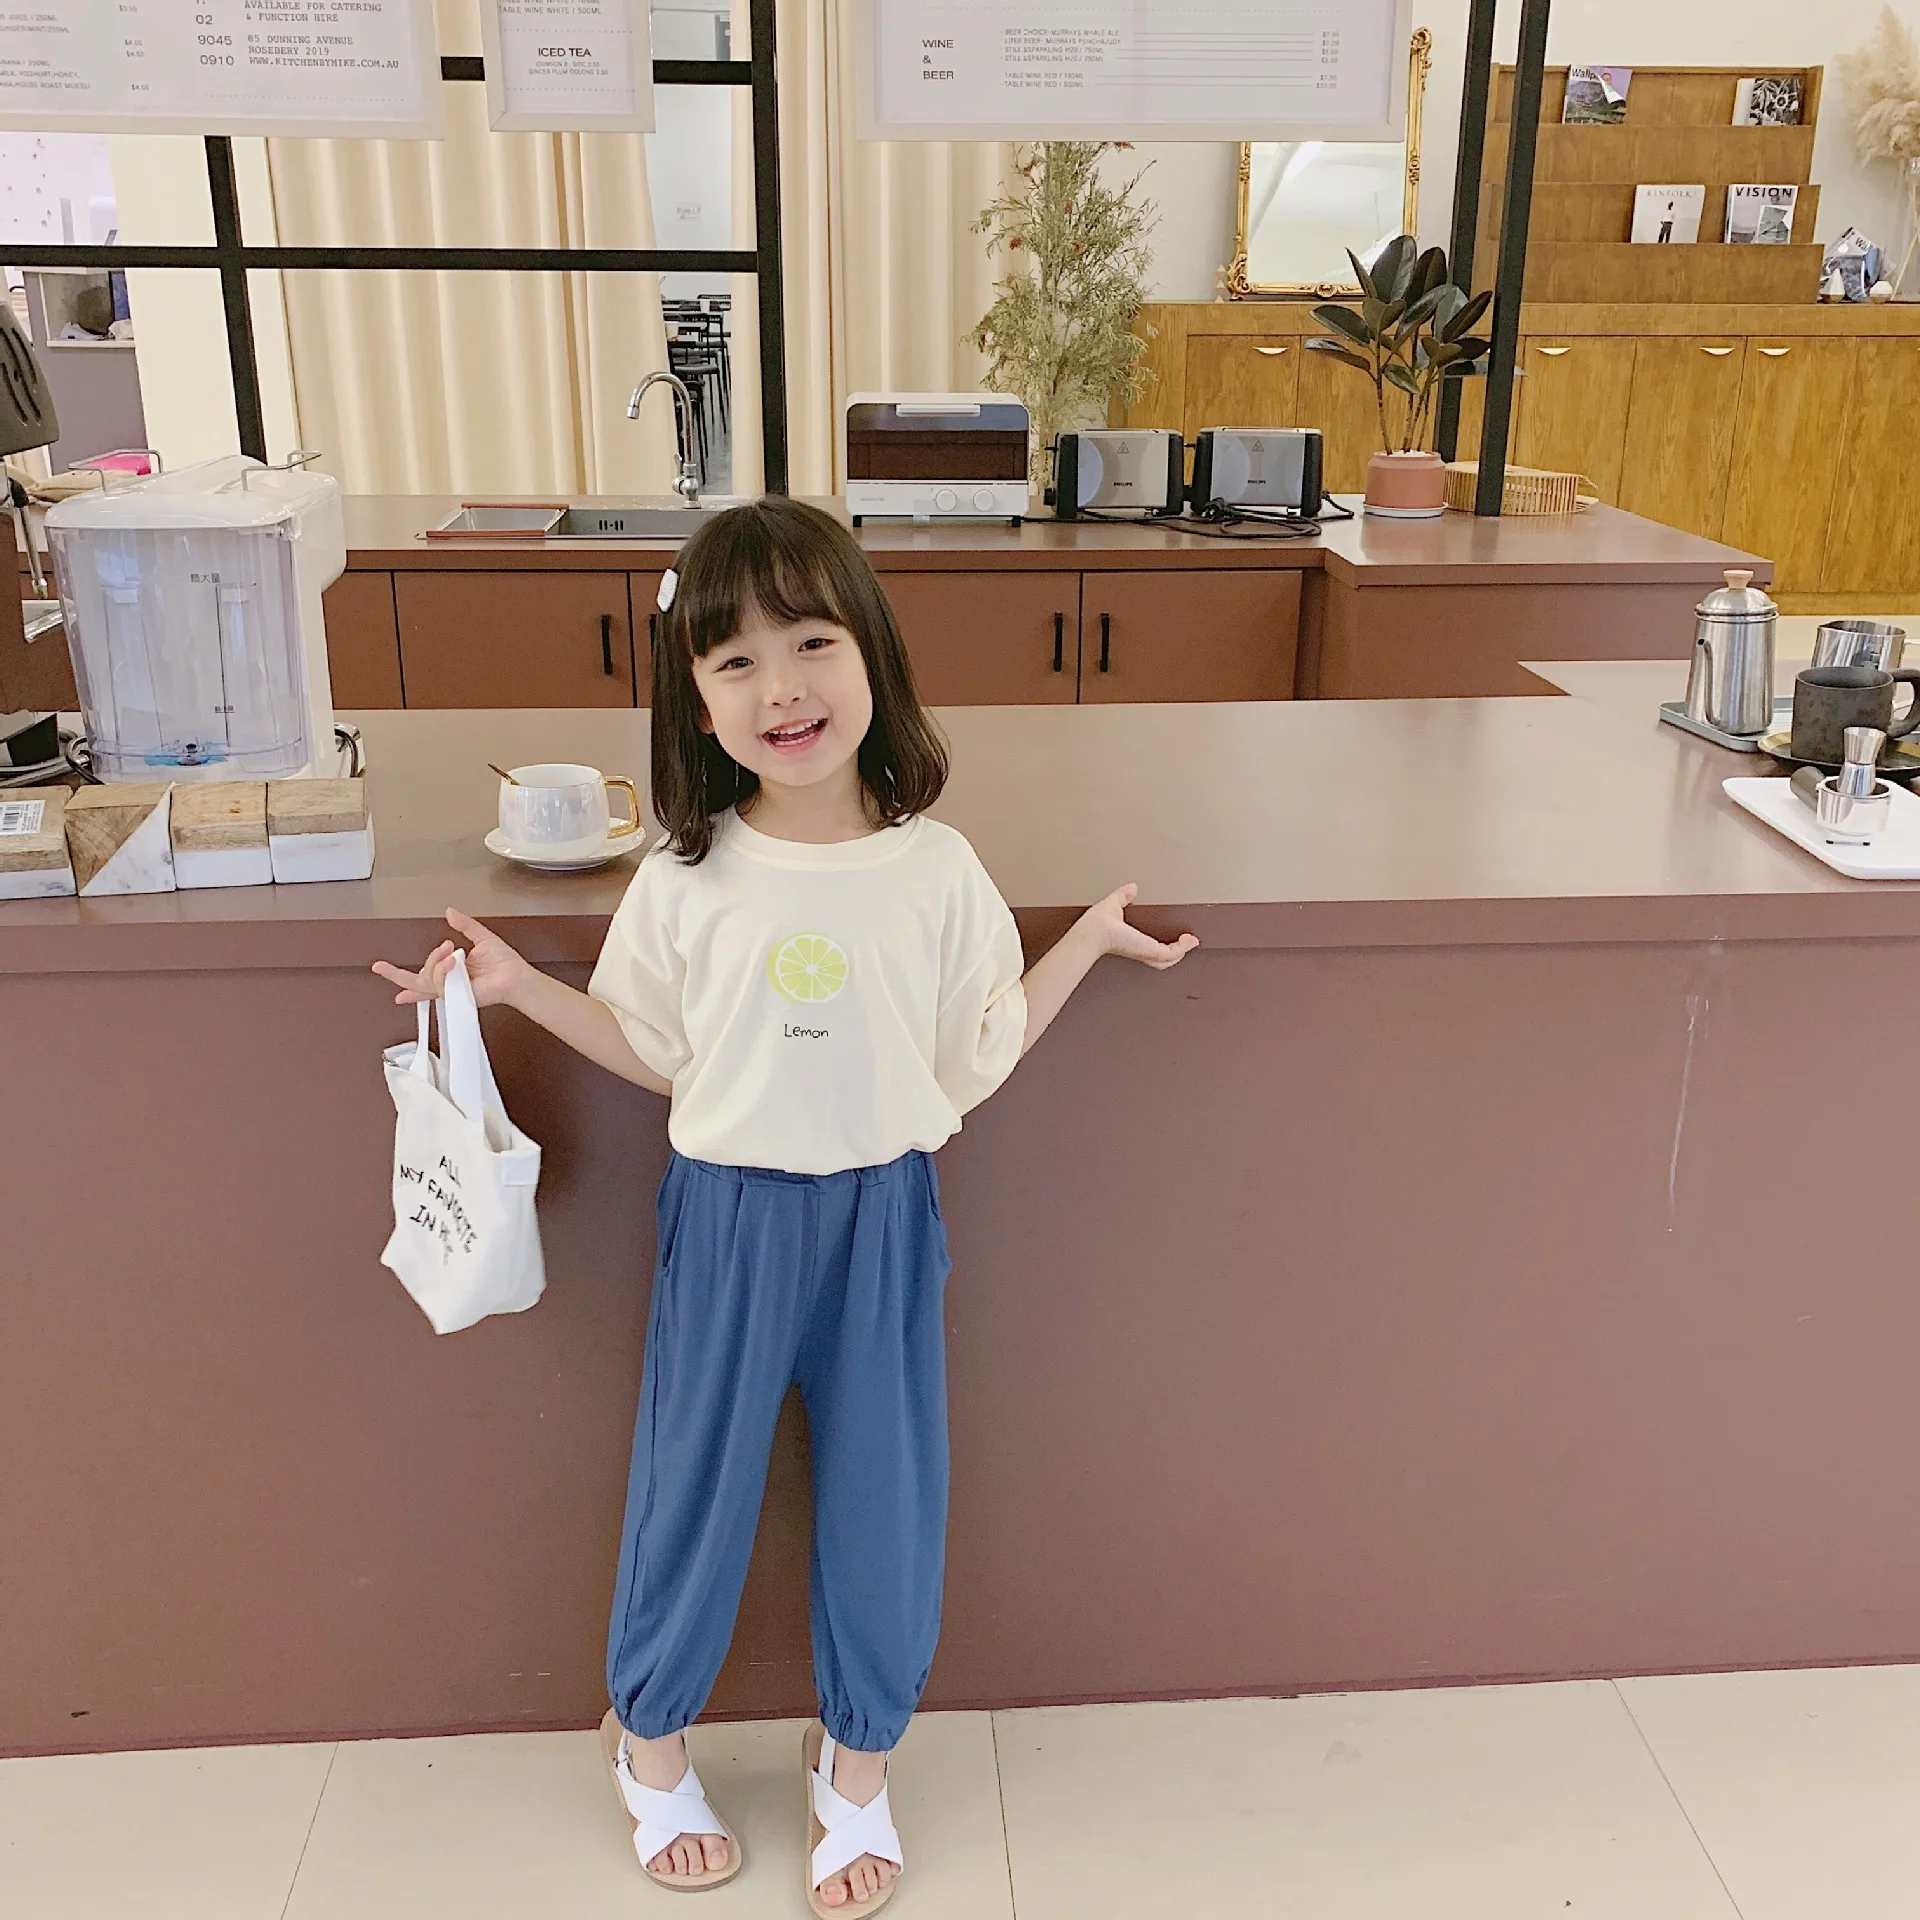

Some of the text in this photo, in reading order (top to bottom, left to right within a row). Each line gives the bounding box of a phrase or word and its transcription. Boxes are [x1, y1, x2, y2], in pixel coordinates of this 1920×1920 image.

[244, 1, 382, 12] AVAILABLE FOR CATERING
[524, 6, 543, 14] WINE
[547, 6, 569, 14] WHITE
[195, 14, 213, 25] 02
[258, 12, 309, 21] FUNCTION
[314, 13, 339, 22] HIRE
[1005, 28, 1022, 36] BEER
[197, 34, 233, 45] 9045
[247, 34, 353, 45] 85 DUNNING AVENUE
[922, 39, 954, 48] WINE
[248, 46, 330, 56] ROSEBERY 2019
[538, 47, 592, 57] ICED TEA
[199, 54, 235, 66] 0910
[248, 57, 399, 69] WWW.KITCHENBYMIKE.COM.AU
[922, 54, 932, 64] &
[923, 70, 954, 80] BEER
[1735, 186, 1793, 198] VISION
[784, 1023, 829, 1039] Lemon
[400, 1163, 425, 1185] MY
[408, 1204, 437, 1232] IN
